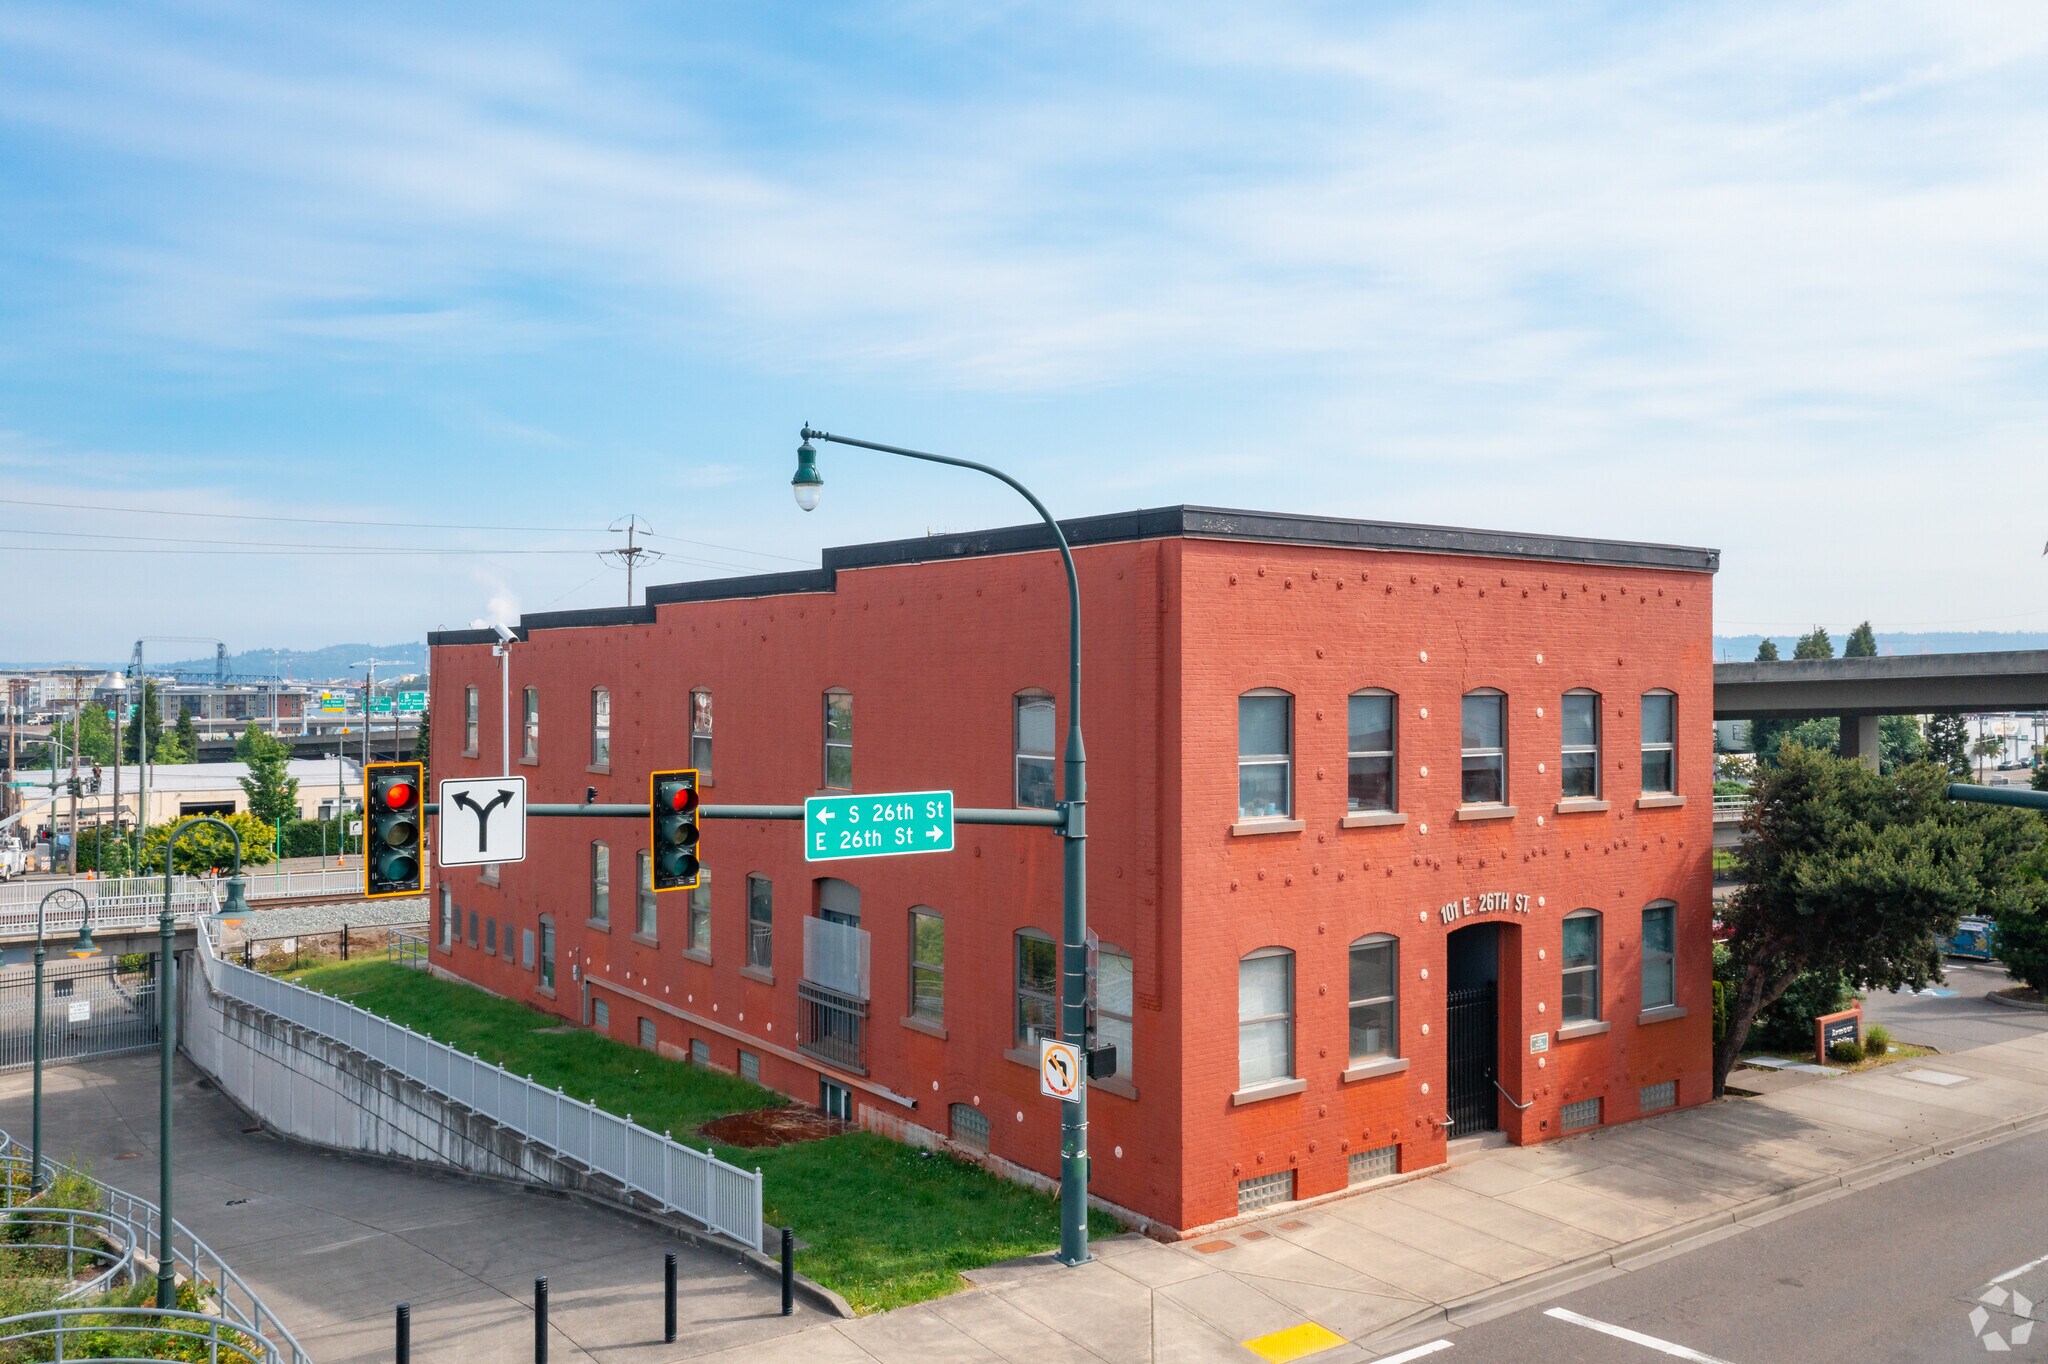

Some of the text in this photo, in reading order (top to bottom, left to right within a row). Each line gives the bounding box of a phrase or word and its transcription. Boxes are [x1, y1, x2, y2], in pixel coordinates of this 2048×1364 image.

[849, 801, 944, 824] S 26th St
[816, 827, 914, 851] E 26th St
[1440, 892, 1531, 924] 101 E. 26TH ST.
